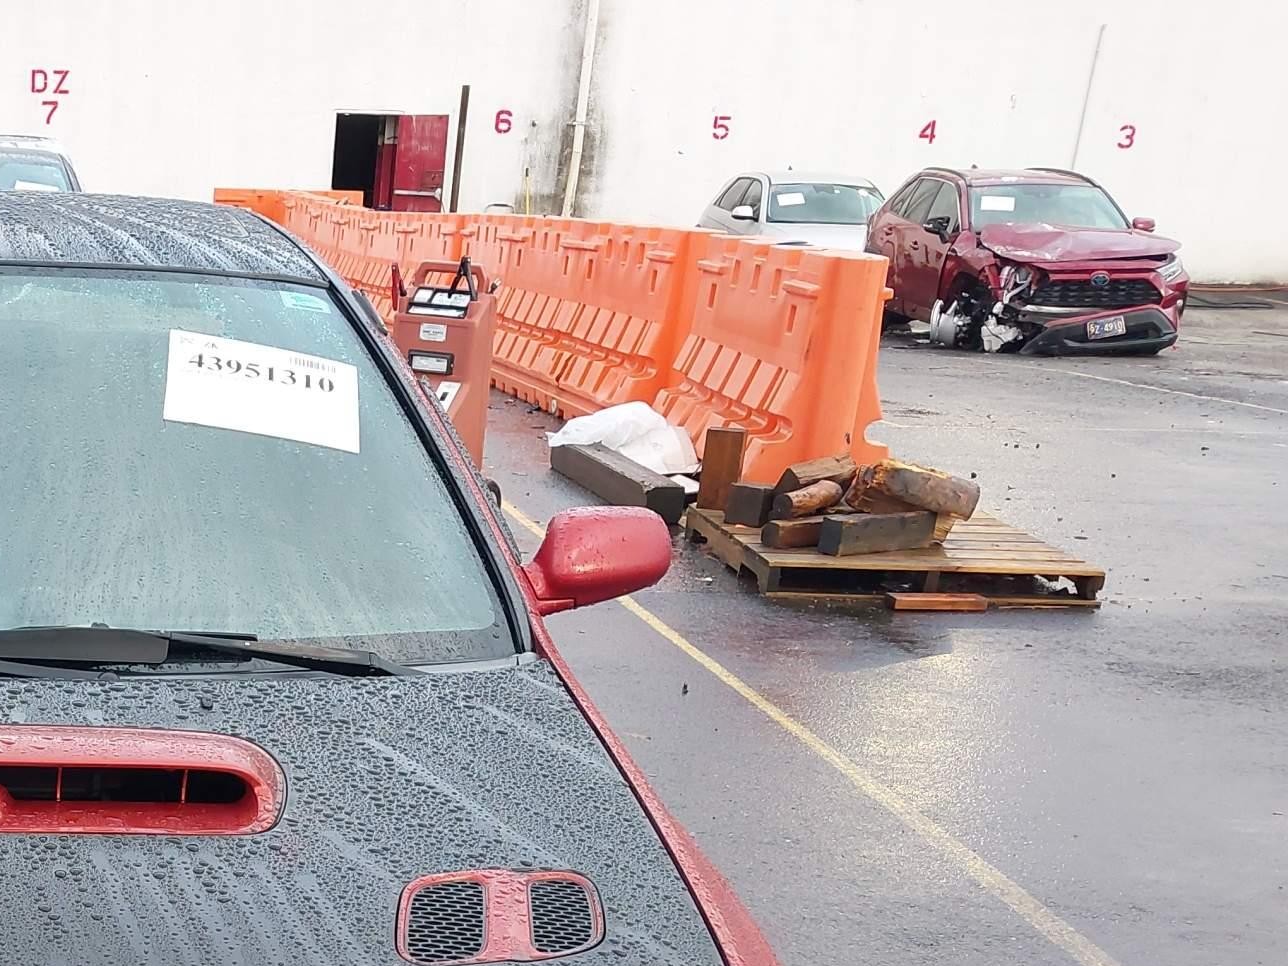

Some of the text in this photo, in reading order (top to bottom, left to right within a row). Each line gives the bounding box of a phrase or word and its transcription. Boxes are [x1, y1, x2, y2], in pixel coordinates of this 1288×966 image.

[31, 69, 70, 95] DZ
[42, 101, 59, 125] 7
[494, 109, 513, 135] 6
[712, 115, 730, 140] 5
[918, 120, 937, 144] 4
[1117, 125, 1136, 149] 3
[188, 353, 335, 393] 43951310
